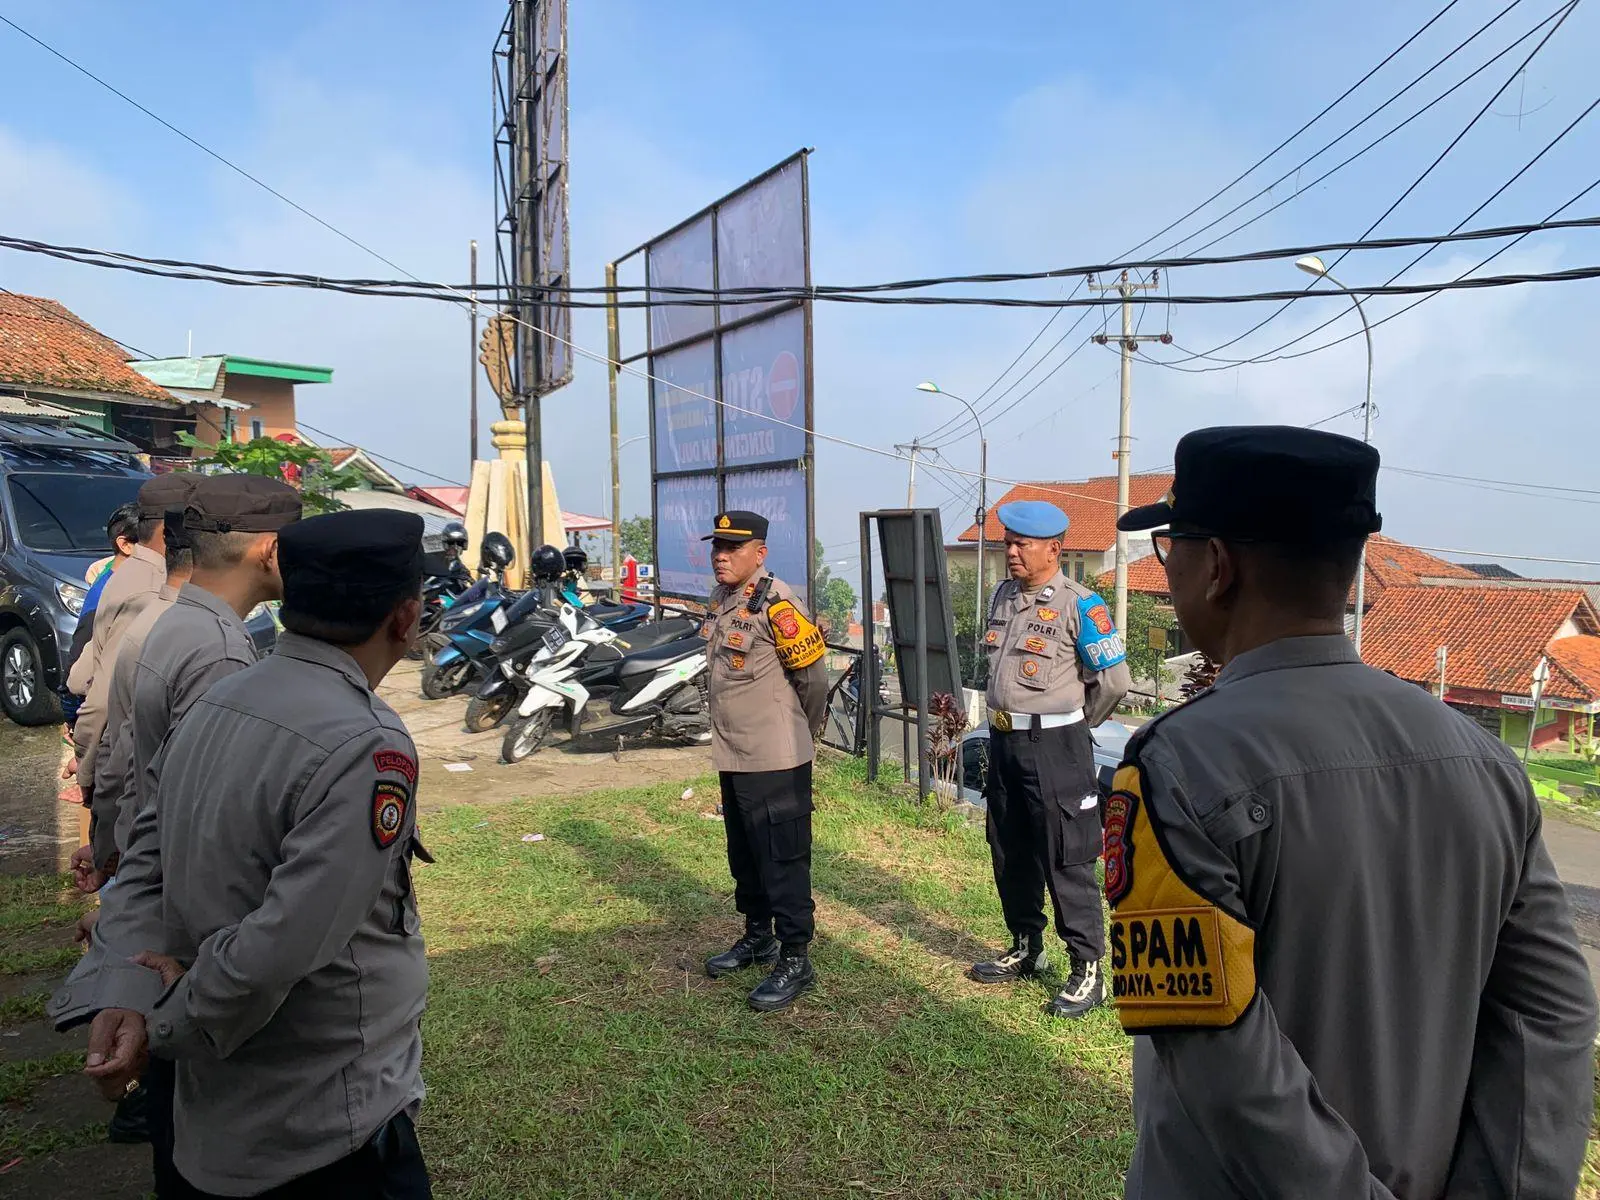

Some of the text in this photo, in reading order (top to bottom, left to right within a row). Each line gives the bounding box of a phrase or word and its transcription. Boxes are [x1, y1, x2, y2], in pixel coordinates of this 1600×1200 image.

[731, 618, 752, 631] POLRI
[1027, 622, 1056, 636] POLRI
[1085, 634, 1125, 666] PRO
